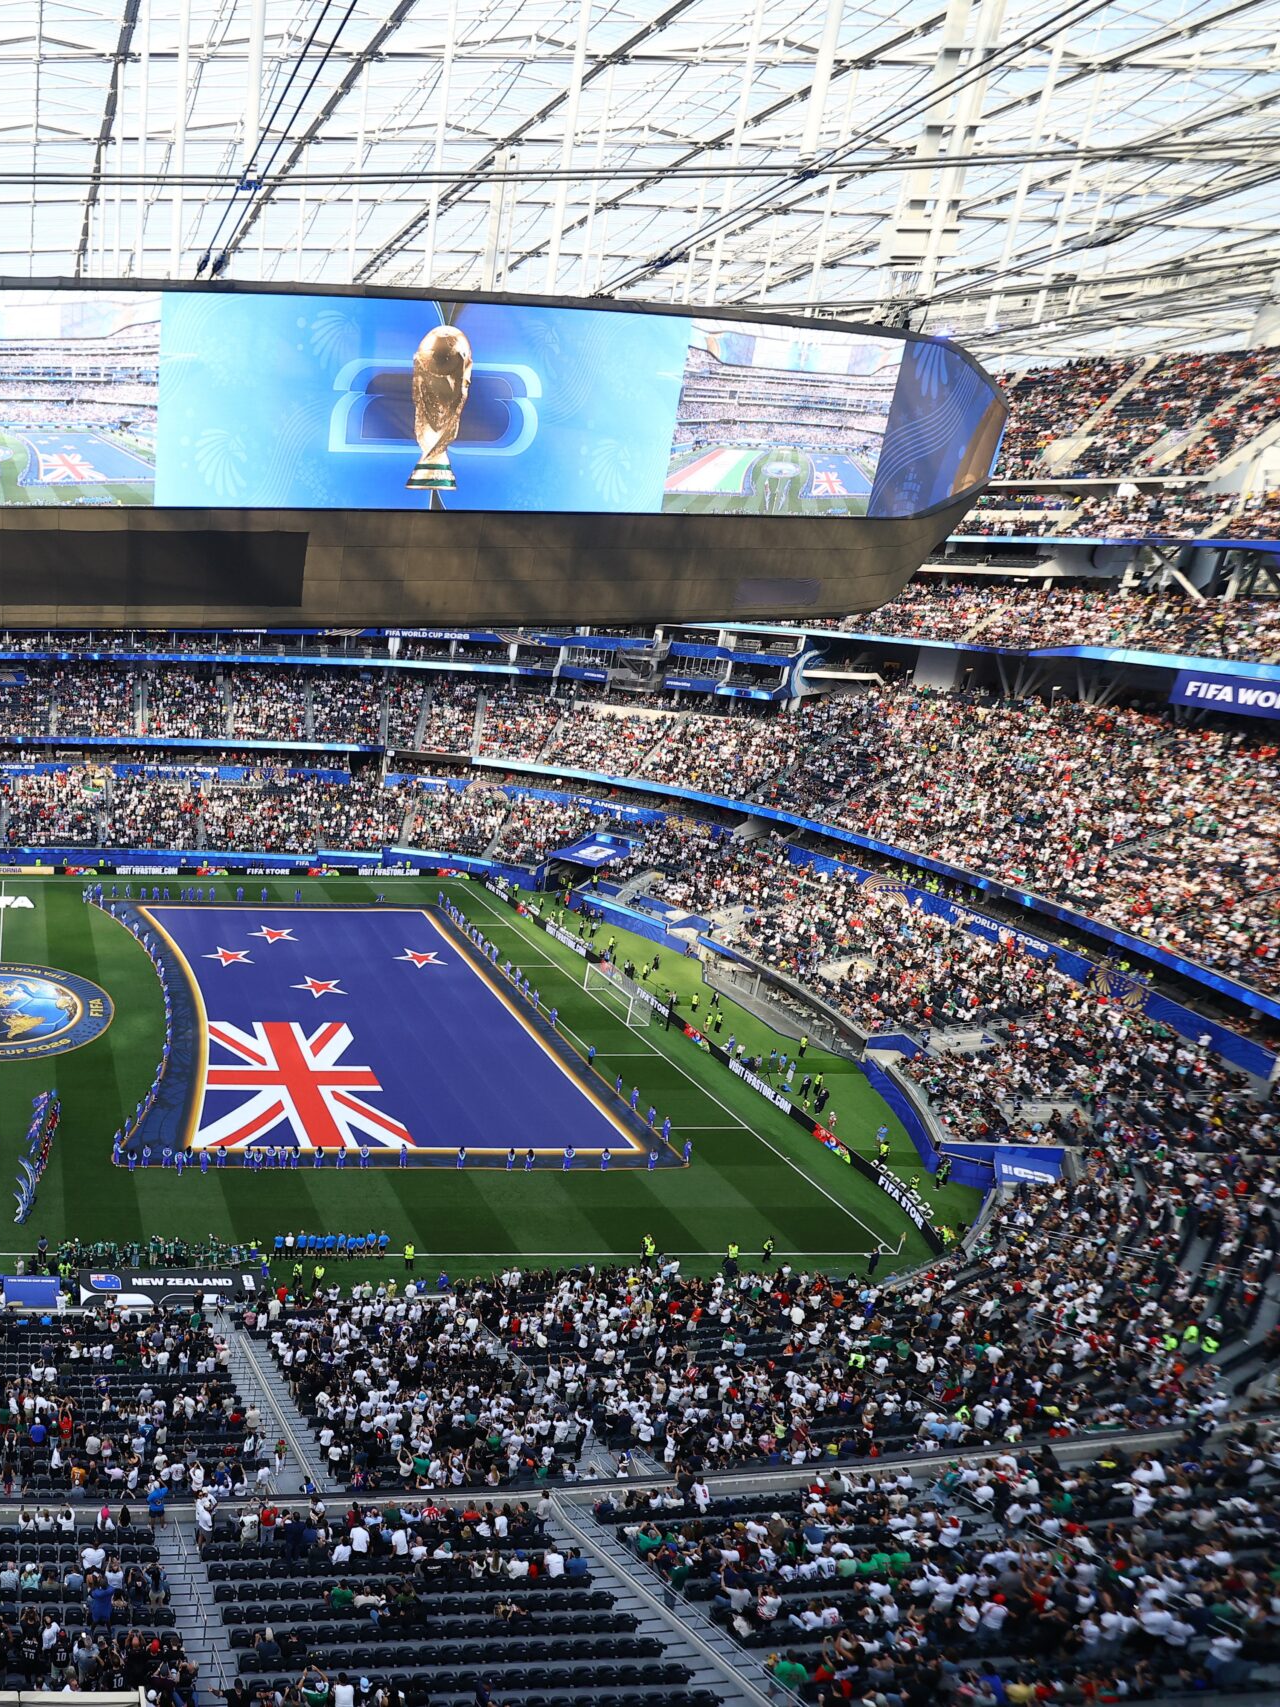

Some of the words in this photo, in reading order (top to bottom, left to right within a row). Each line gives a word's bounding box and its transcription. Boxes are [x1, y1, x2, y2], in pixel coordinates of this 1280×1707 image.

[1184, 681, 1233, 702] FIFA
[593, 800, 639, 814] ANGELES
[116, 867, 131, 875] VISIT
[132, 867, 178, 875] FIFASTORE.COM
[358, 868, 373, 876] VISIT
[1016, 934, 1049, 953] 2026
[43, 971, 68, 981] FIFA
[89, 998, 104, 1017] FIFA
[636, 987, 650, 1003] FIFA
[650, 997, 670, 1017] STORE
[27, 1038, 72, 1054] 2026
[729, 1058, 745, 1078] VISIT
[743, 1070, 792, 1115] FIFASTORE.COM
[877, 1175, 901, 1201] FIFA
[900, 1196, 925, 1230] STORE
[131, 1277, 166, 1287] NEW
[168, 1277, 233, 1287] ZEALAND
[56, 1652, 67, 1662] 10
[113, 1677, 124, 1689] 10
